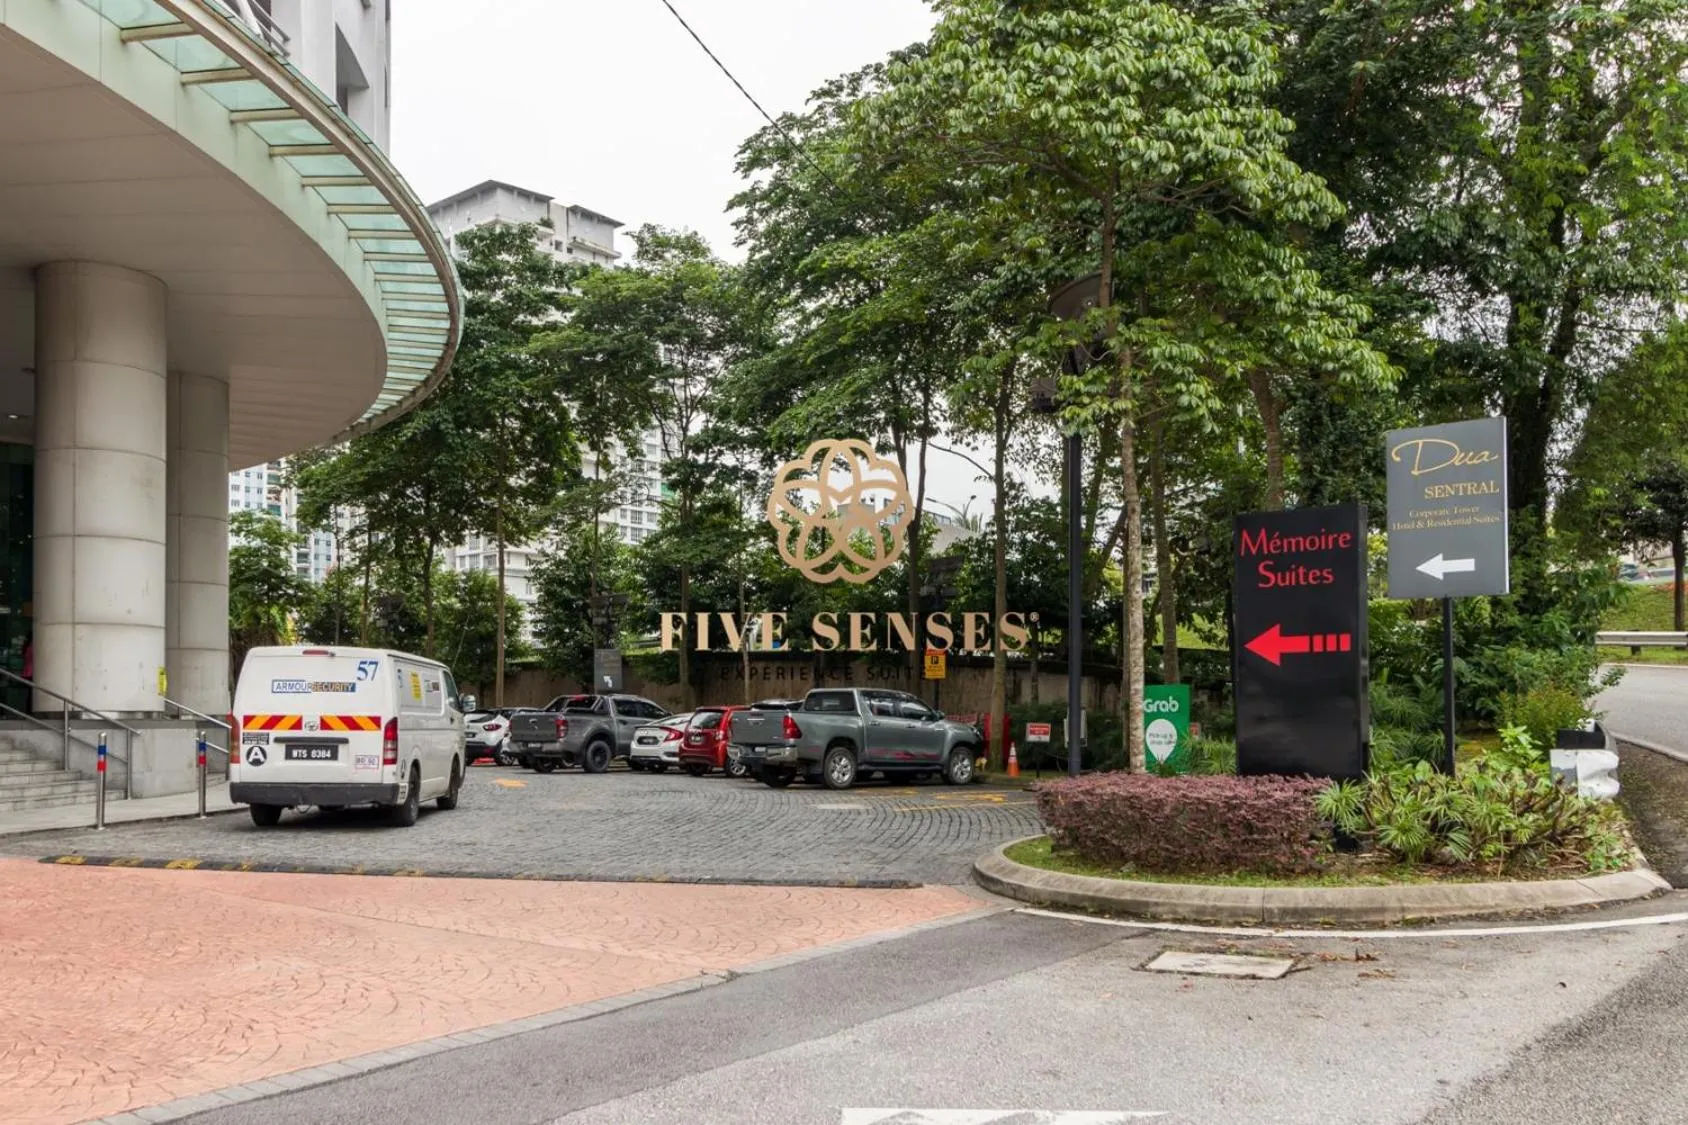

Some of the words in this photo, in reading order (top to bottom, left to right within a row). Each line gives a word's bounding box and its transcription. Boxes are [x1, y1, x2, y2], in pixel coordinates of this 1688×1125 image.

[1391, 438, 1499, 476] Dua
[1424, 480, 1500, 499] SENTRAL
[1240, 527, 1352, 556] Mémoire
[1257, 560, 1335, 588] Suites
[356, 660, 379, 681] 57
[1143, 695, 1179, 713] Grab
